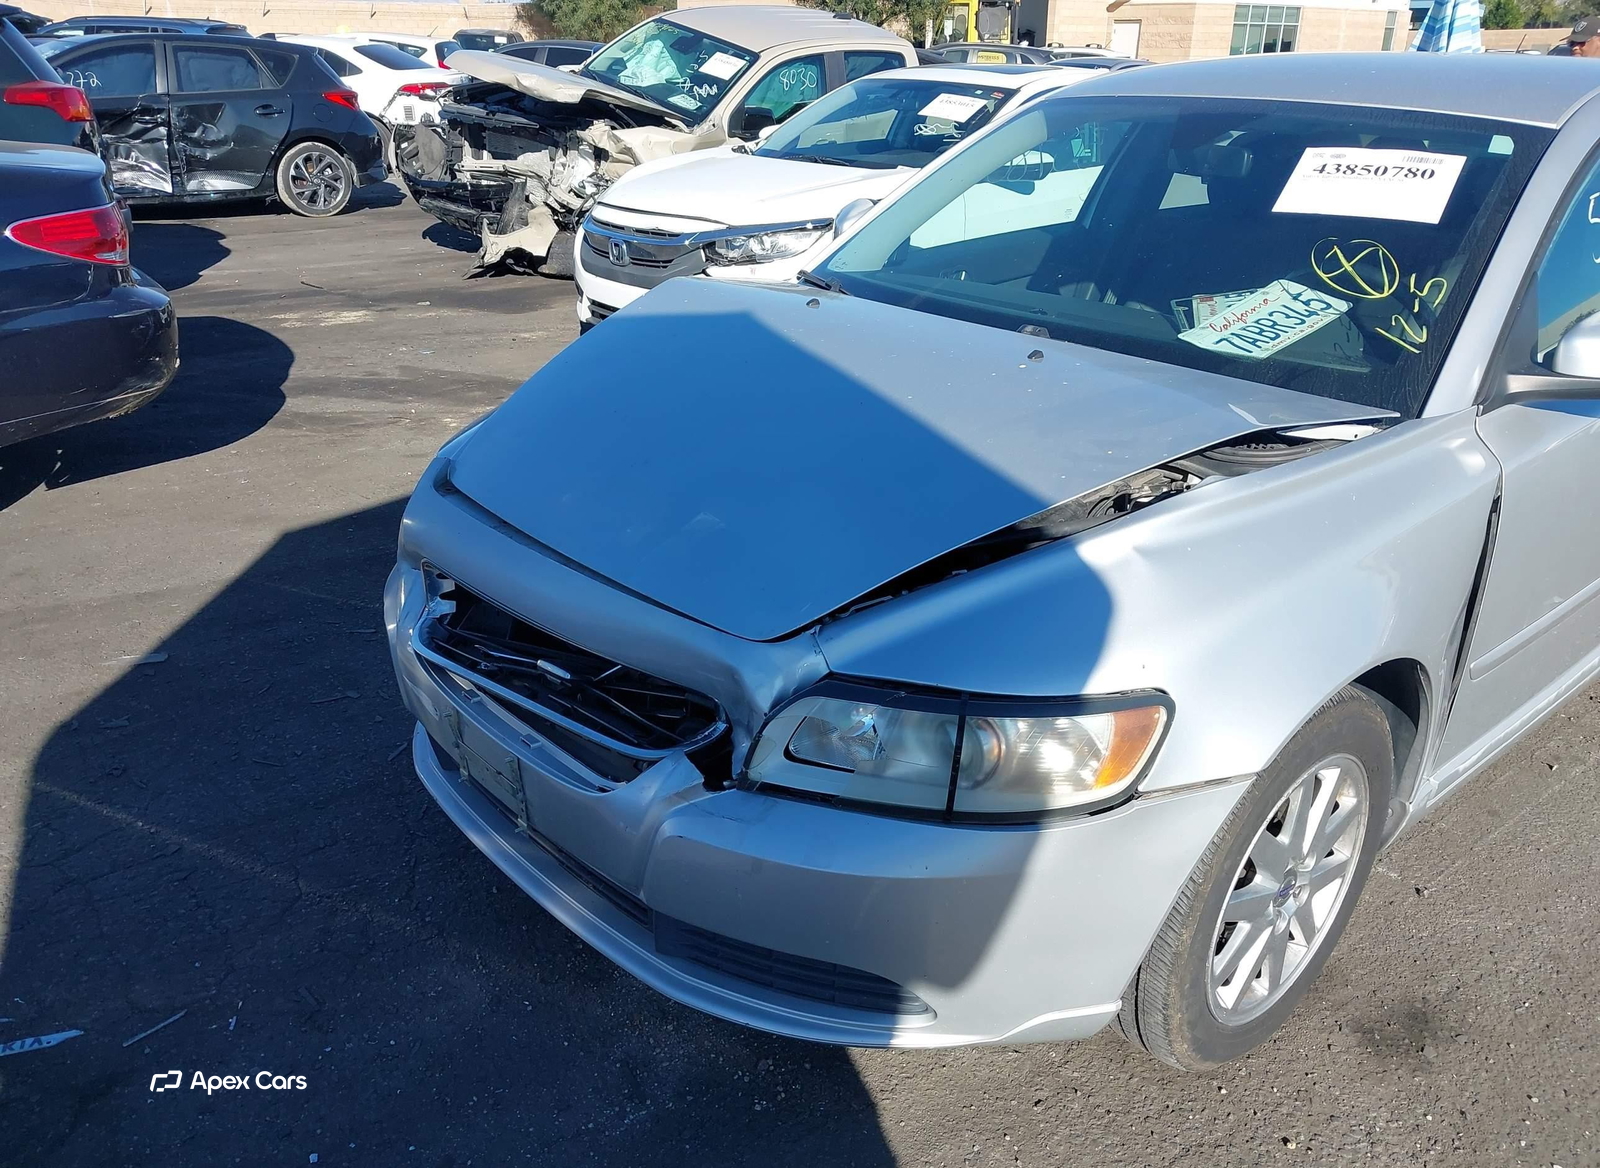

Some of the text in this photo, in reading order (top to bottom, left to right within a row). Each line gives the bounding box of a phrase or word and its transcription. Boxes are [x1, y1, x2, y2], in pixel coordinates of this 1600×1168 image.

[779, 67, 818, 91] 8030
[1312, 163, 1436, 180] 43850780
[1208, 289, 1284, 333] California
